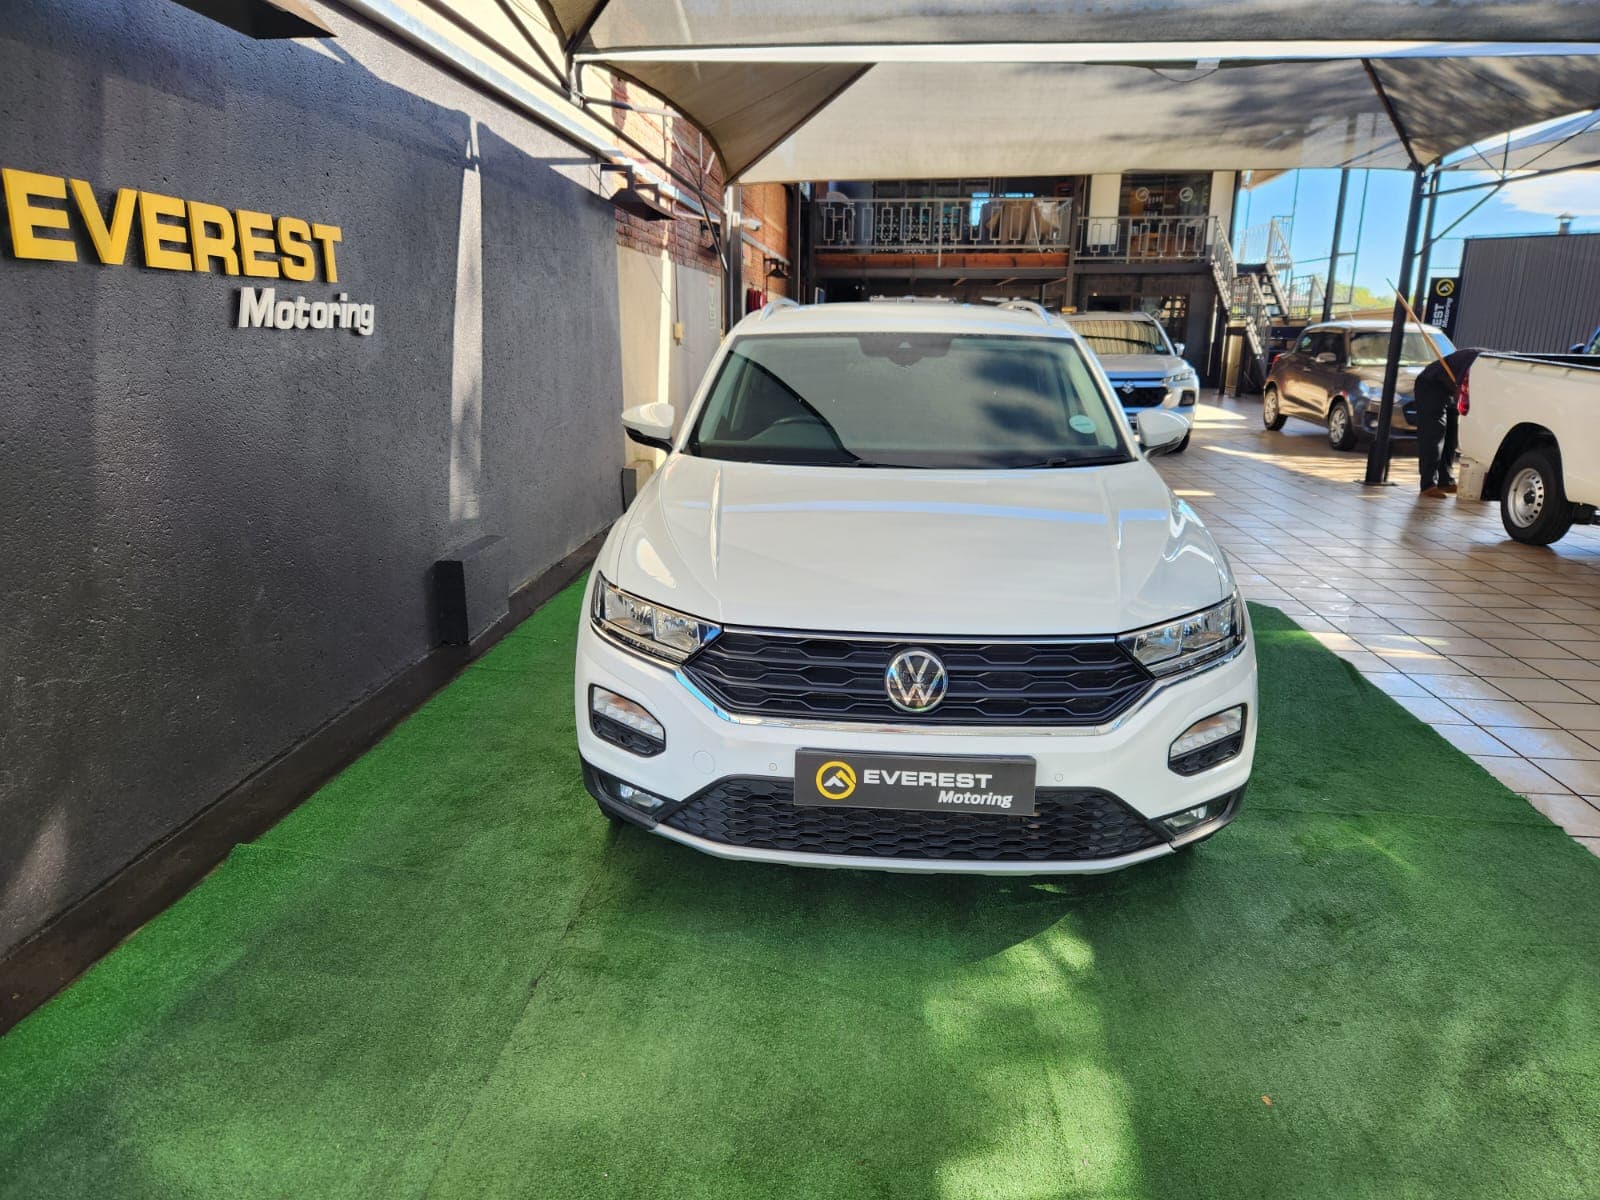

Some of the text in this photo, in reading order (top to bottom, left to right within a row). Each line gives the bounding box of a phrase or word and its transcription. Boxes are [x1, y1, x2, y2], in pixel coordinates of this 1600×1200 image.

[2, 168, 343, 283] EVEREST
[238, 286, 375, 336] Motoring
[863, 769, 993, 789] EVEREST
[938, 790, 1013, 808] Motoring
